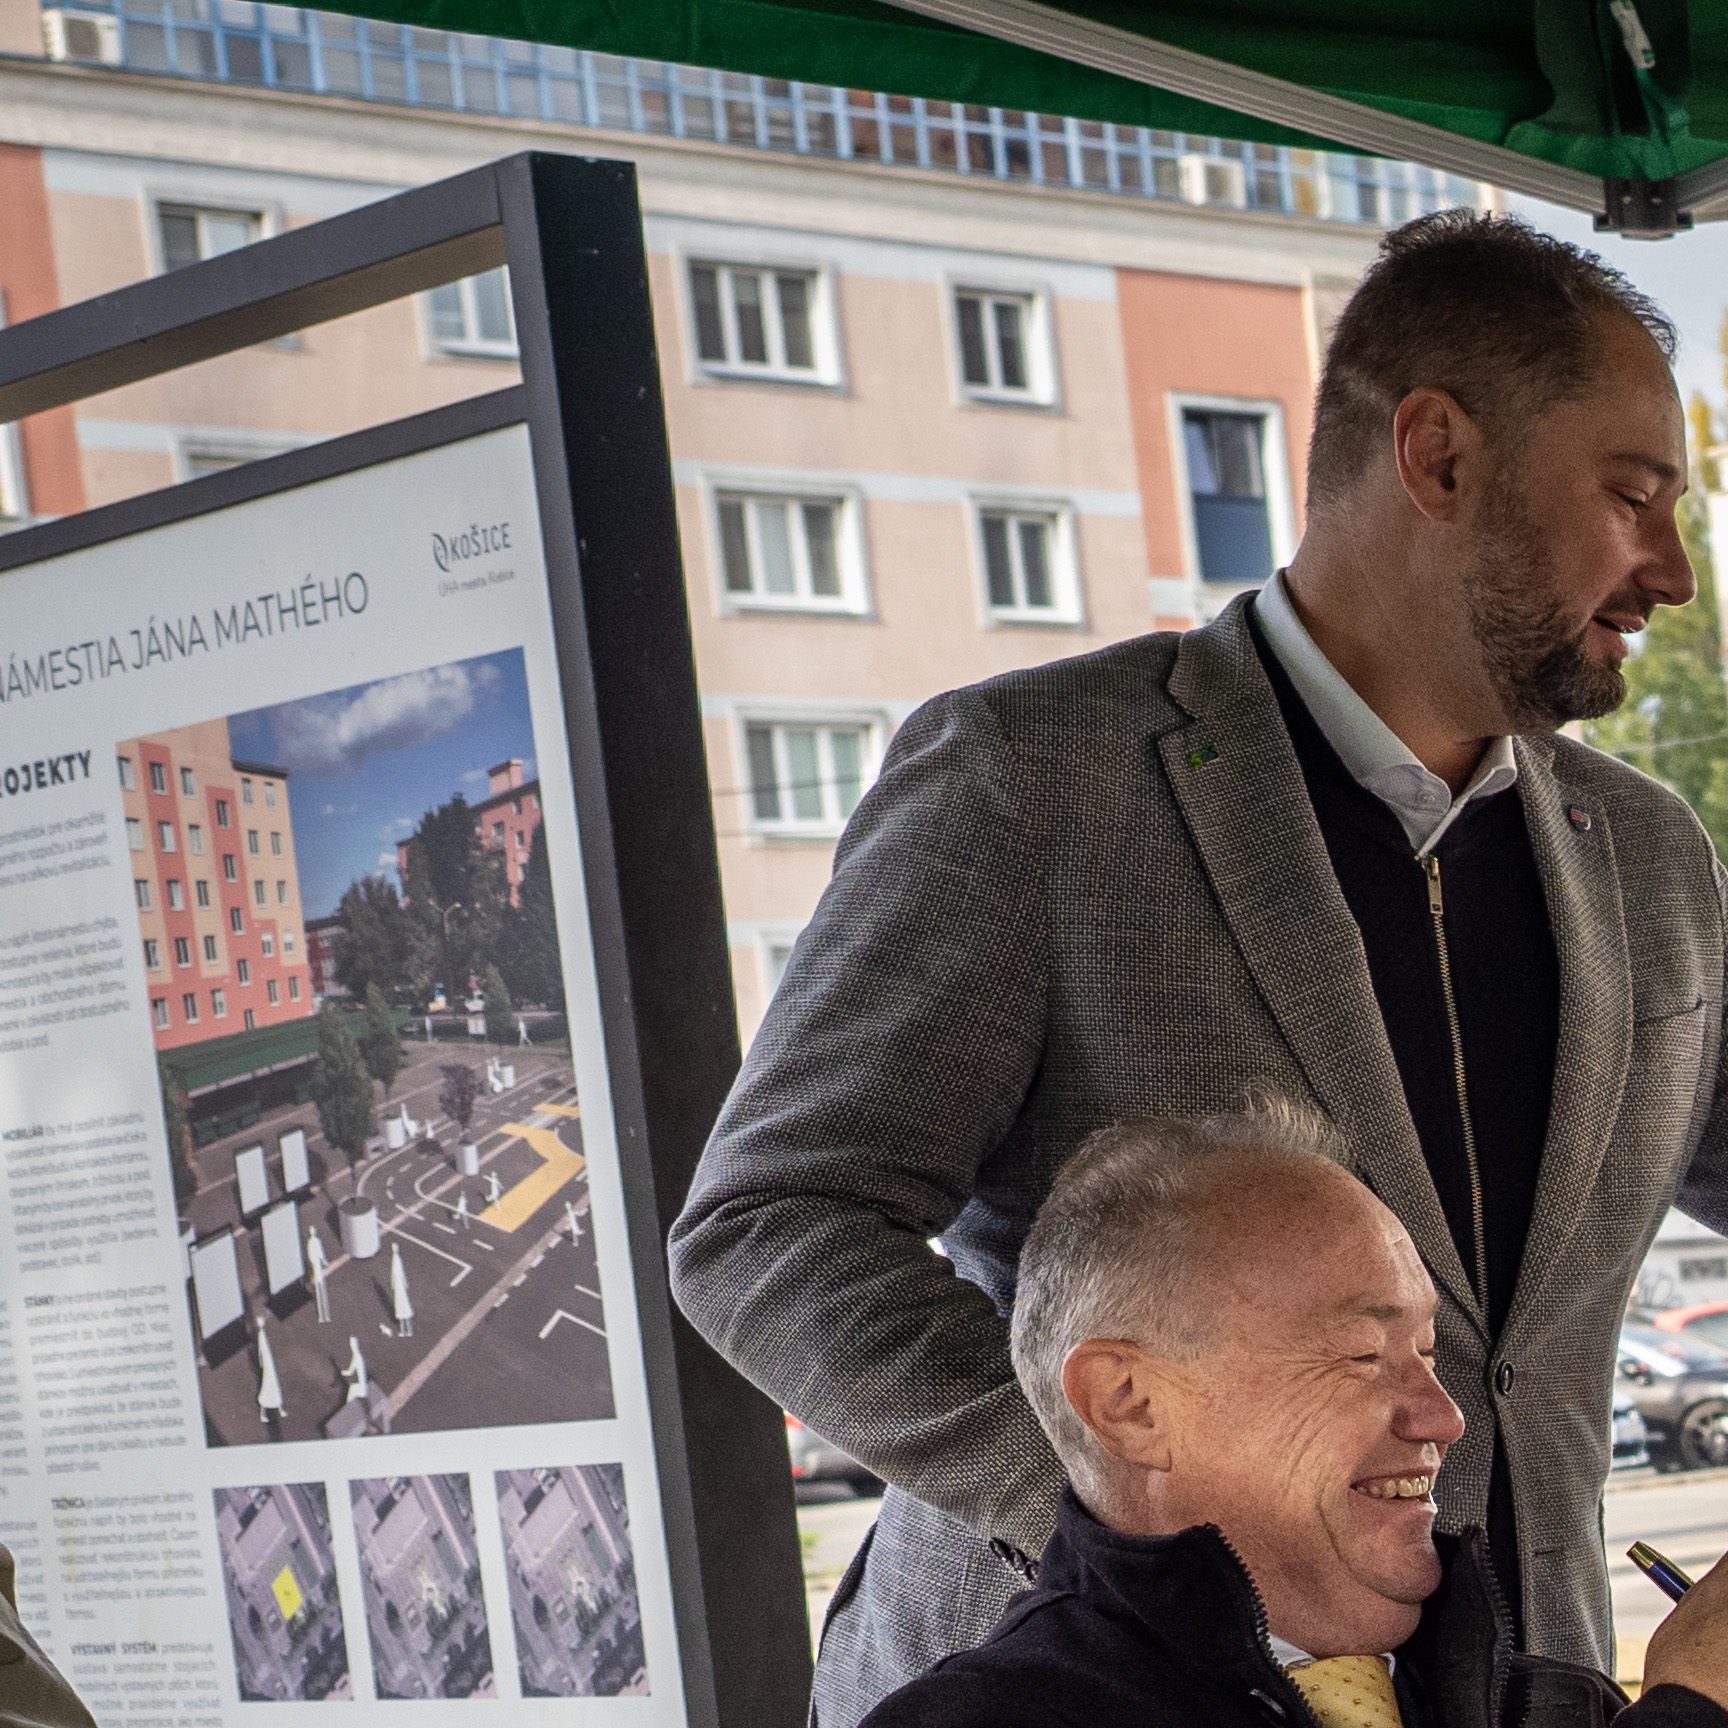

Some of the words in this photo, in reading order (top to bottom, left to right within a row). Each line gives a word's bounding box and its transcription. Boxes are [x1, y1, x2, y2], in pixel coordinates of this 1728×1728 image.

[450, 522, 512, 561] KOŠICE
[0, 636, 127, 702] ÁMESTIA
[130, 614, 209, 670] JÁNA
[213, 571, 370, 649] MATHÉHO
[0, 749, 92, 799] OJEKTY
